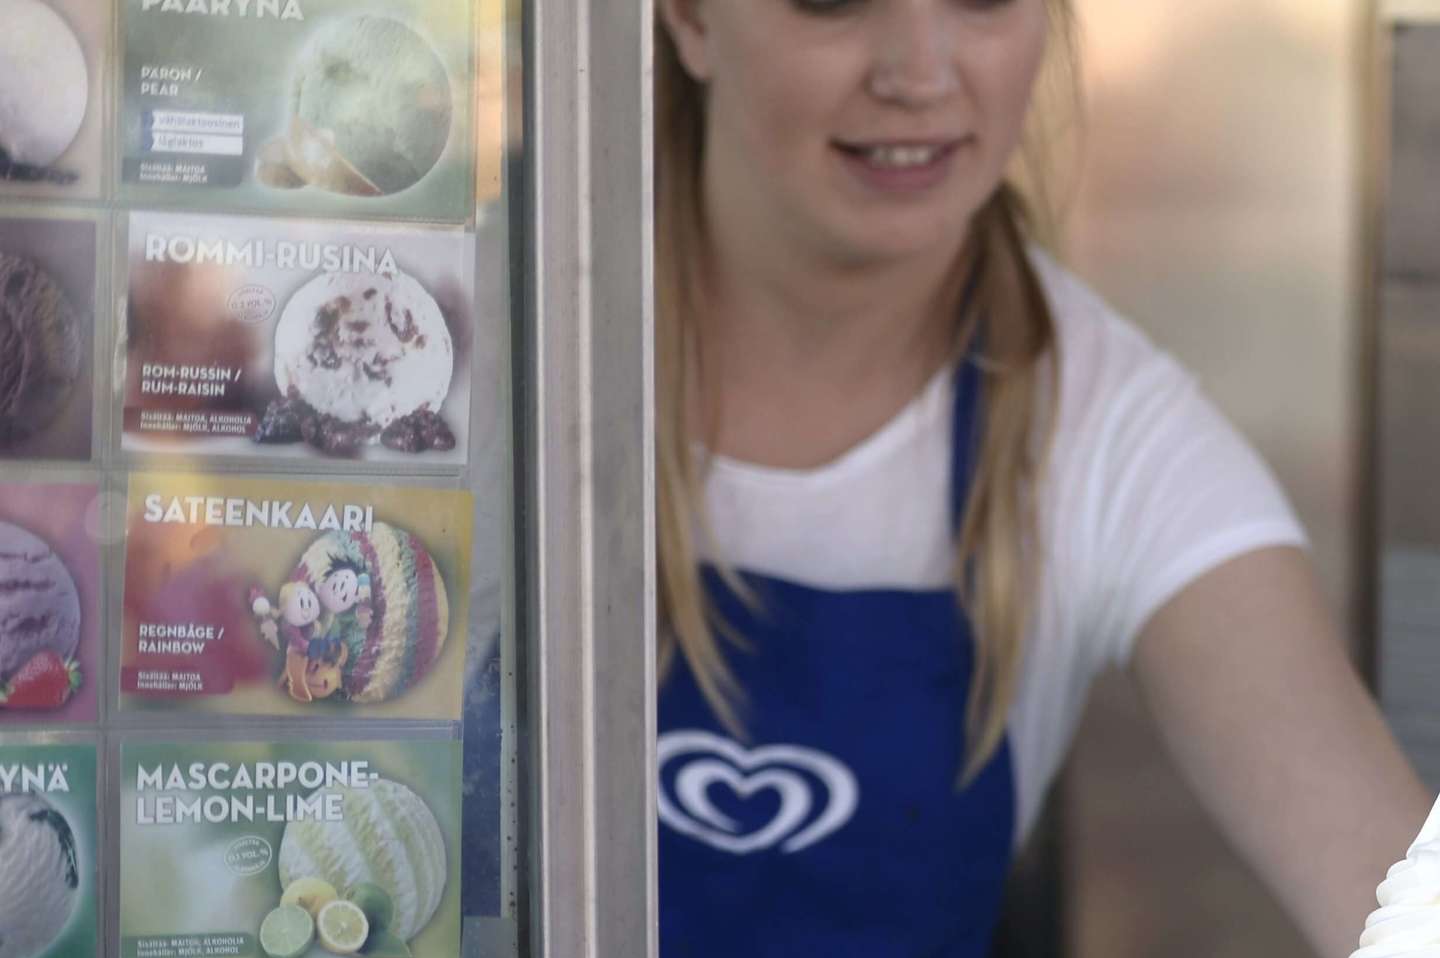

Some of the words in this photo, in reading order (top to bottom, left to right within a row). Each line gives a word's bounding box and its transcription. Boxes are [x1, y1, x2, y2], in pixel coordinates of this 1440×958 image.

[141, 82, 178, 96] PEAR
[146, 233, 398, 274] ROMMI-RUSINA
[144, 494, 373, 532] SATEENKAARI
[139, 622, 214, 639] REGNBÅGE
[139, 641, 205, 655] RAINBOW
[0, 763, 70, 792] YNÄ
[137, 761, 379, 791] MASCARPONE-
[137, 794, 344, 824] LEMON-LIME
